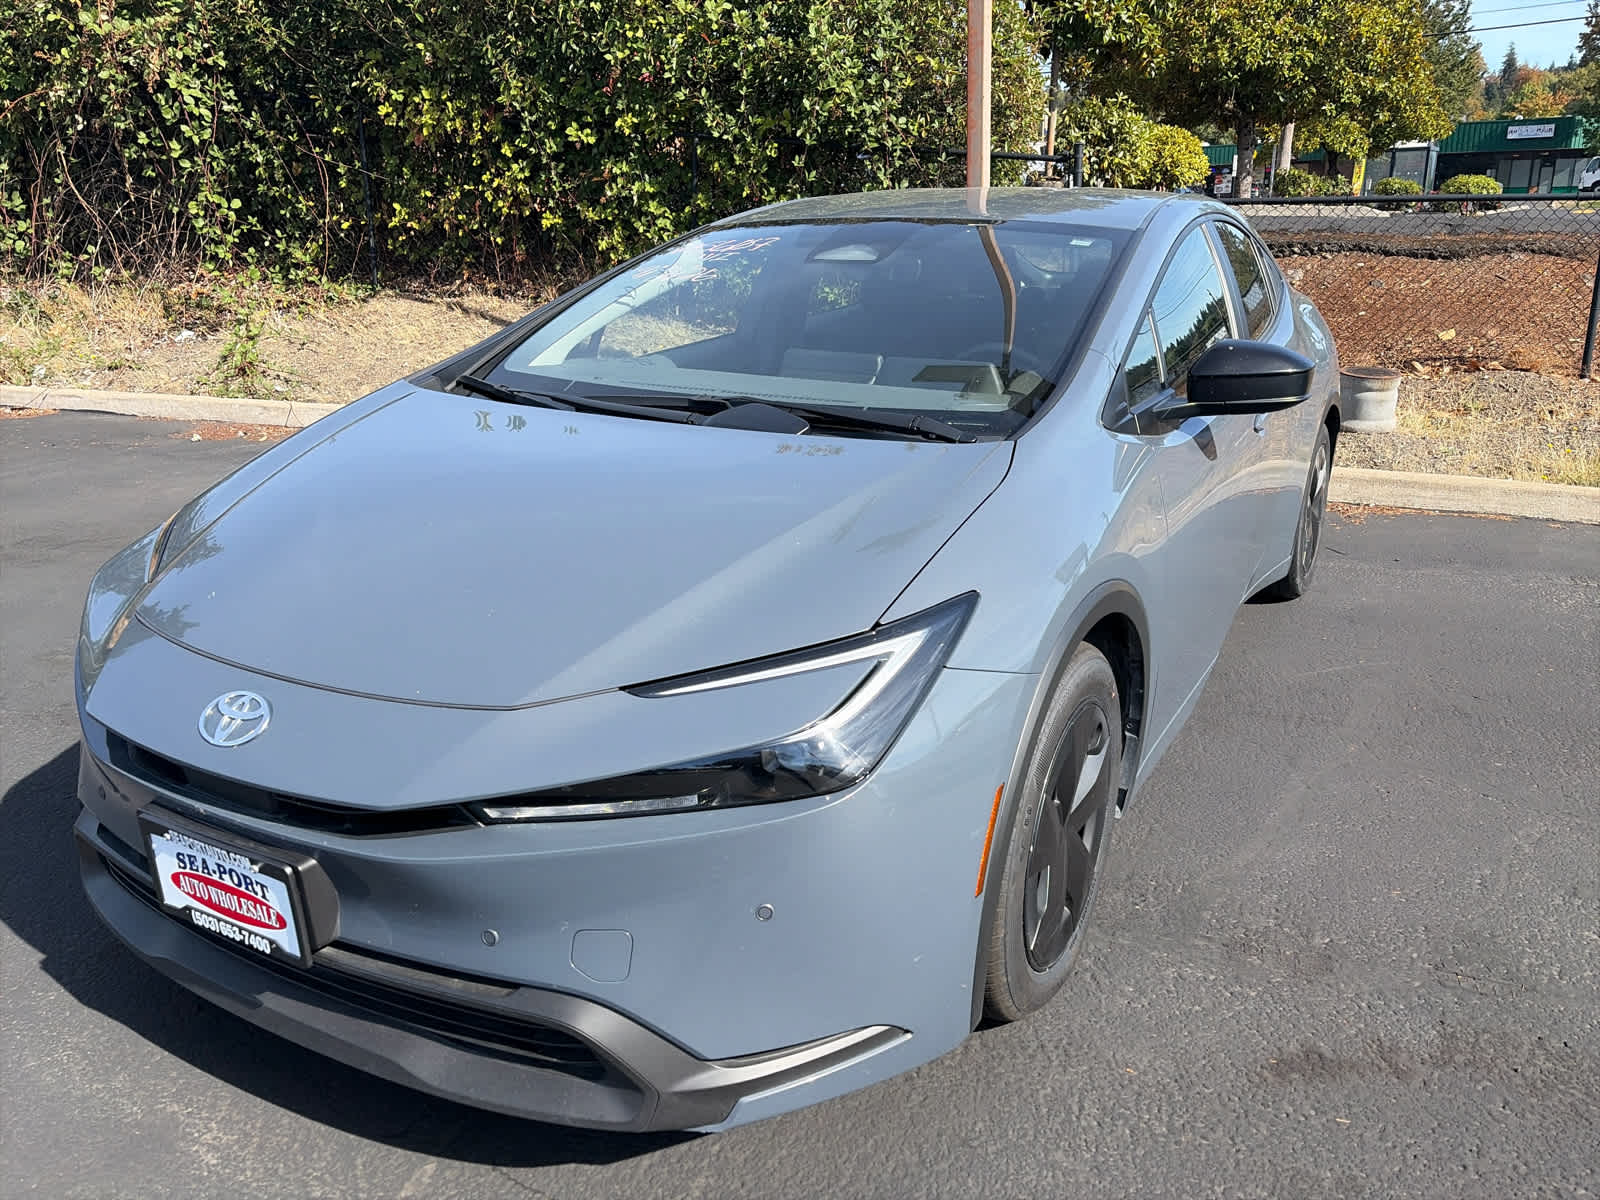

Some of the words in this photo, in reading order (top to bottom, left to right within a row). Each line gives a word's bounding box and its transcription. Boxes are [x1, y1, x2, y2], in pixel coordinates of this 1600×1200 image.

[176, 852, 269, 901] SEA-PORT
[180, 874, 208, 900] AUTO
[207, 885, 280, 928] WHOLESALE
[191, 909, 219, 933] (503)
[219, 921, 271, 955] 653-7400
